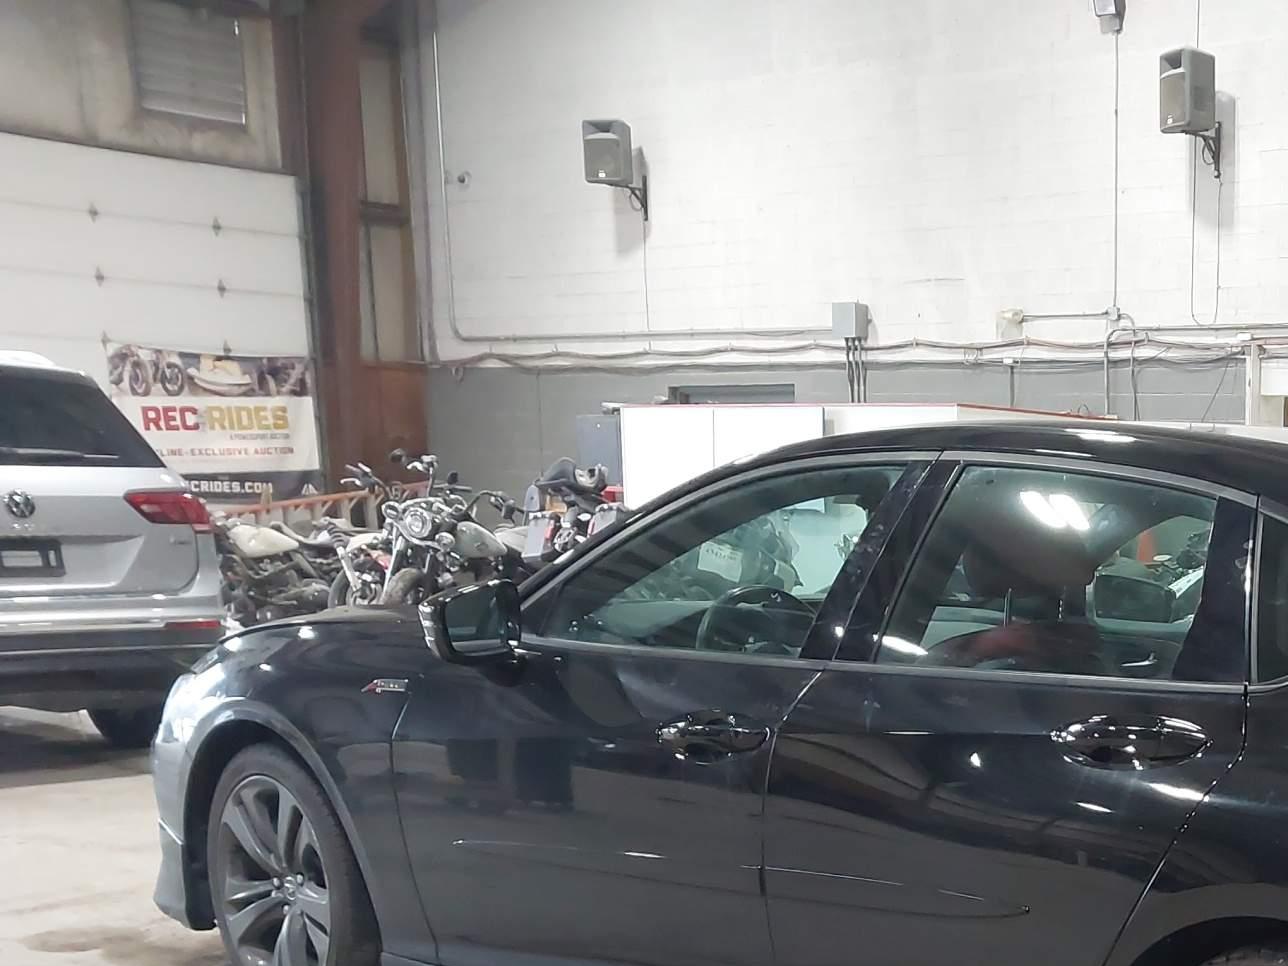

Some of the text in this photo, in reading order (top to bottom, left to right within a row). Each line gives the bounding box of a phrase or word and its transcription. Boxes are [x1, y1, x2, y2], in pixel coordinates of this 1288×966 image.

[141, 405, 200, 431] REC
[206, 405, 289, 431] RIDES
[157, 446, 295, 457] LINE-EXCLUSIVE AUCTION
